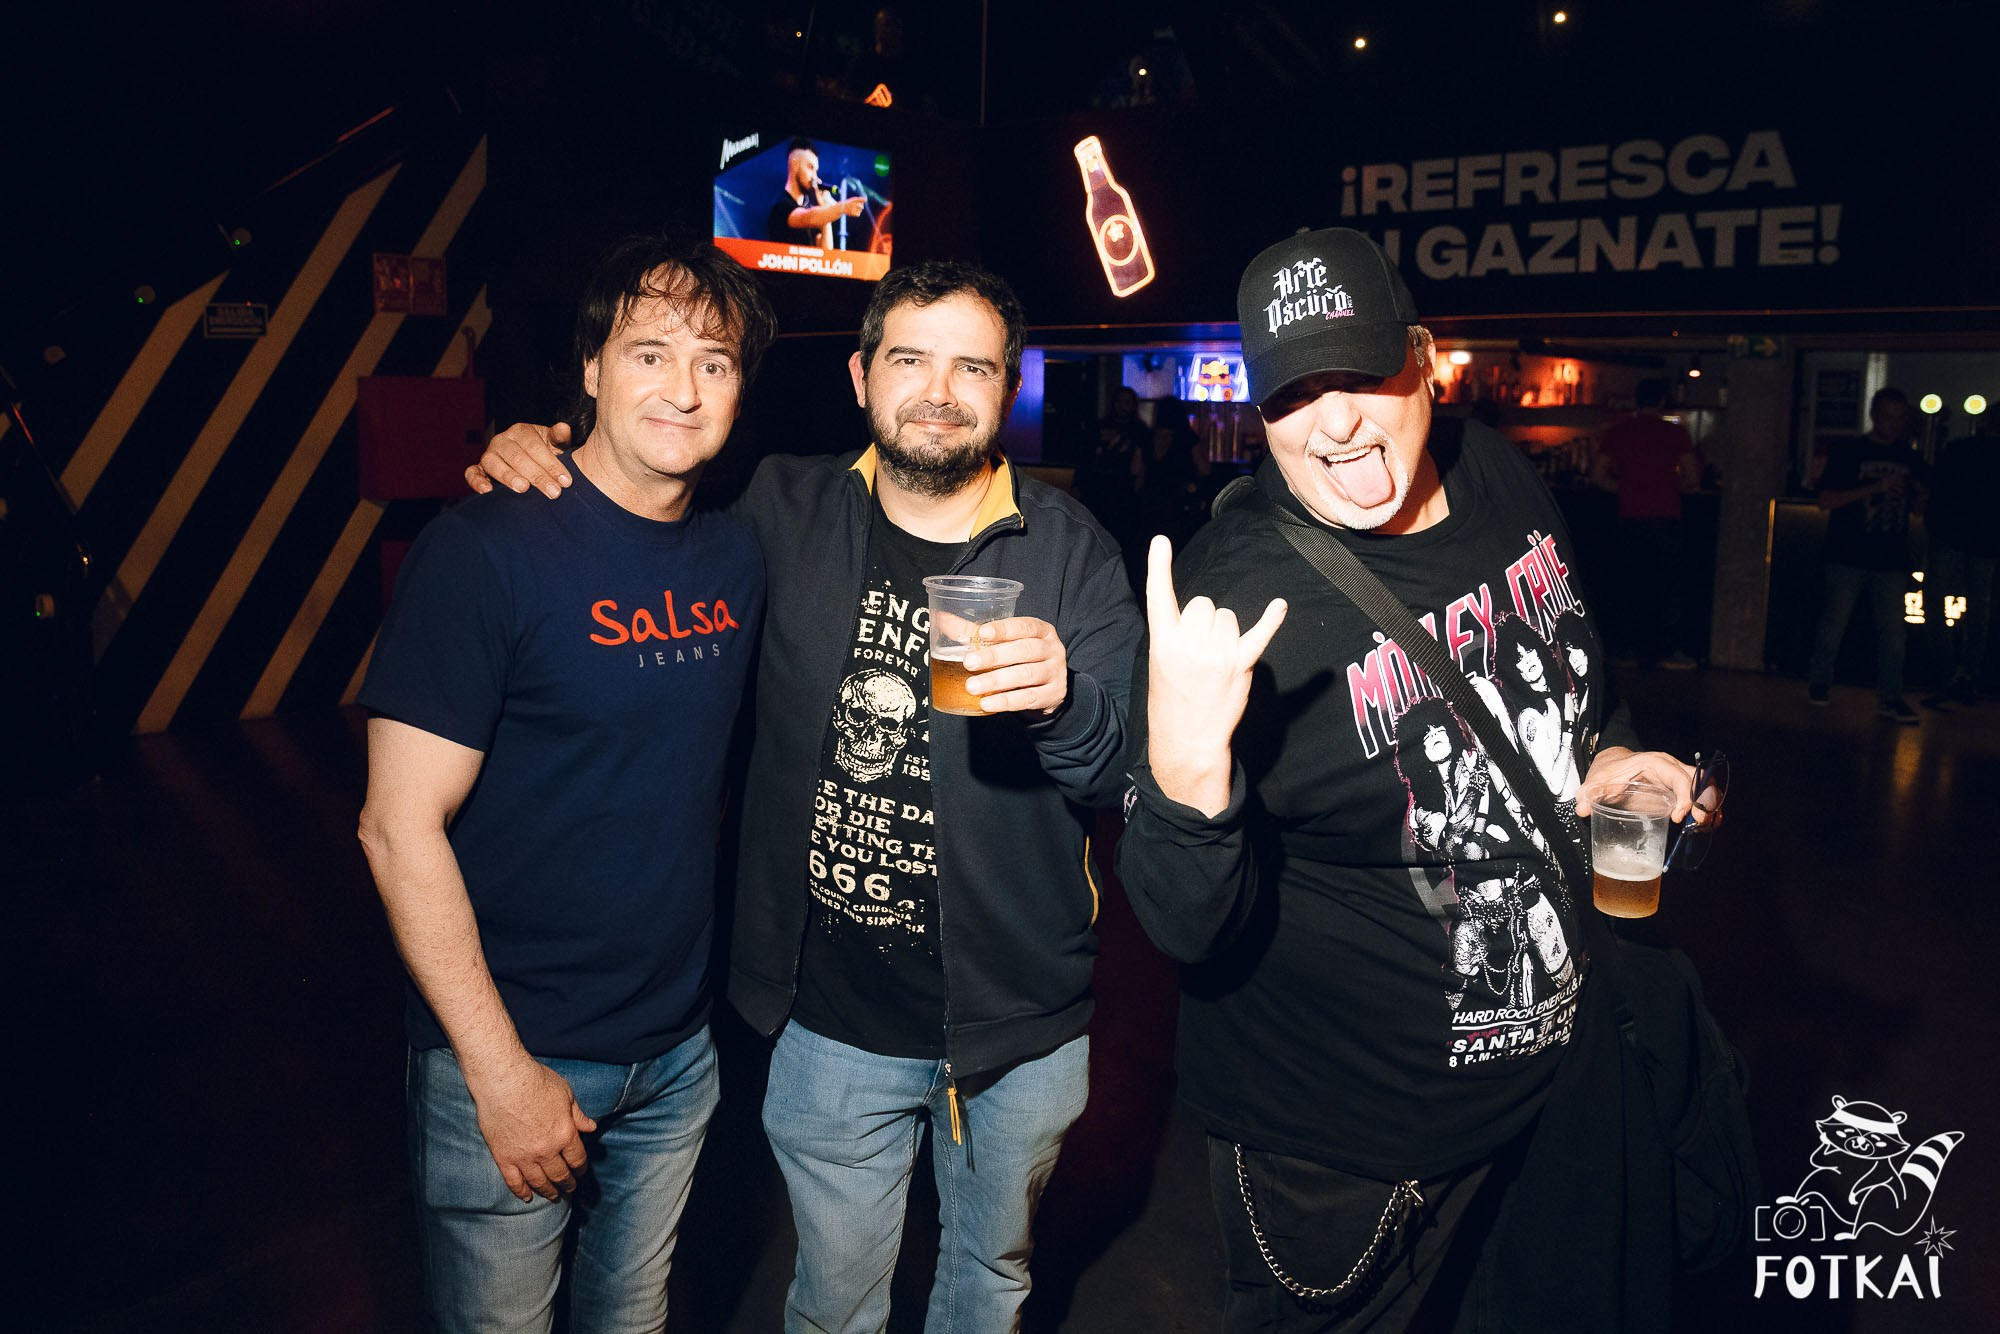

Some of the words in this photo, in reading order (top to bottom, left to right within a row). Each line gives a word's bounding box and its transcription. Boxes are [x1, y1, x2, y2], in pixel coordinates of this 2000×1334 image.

[1340, 130, 1797, 217] ¡REFRESCA
[1415, 203, 1843, 280] GAZNATE!
[758, 253, 798, 271] JOHN
[638, 643, 721, 668] JEANS
[853, 647, 920, 678] FOREVER
[1346, 583, 1496, 760] MÖEY
[904, 753, 930, 767] EST
[843, 787, 897, 815] THE
[901, 803, 936, 825] DA
[848, 809, 891, 834] DIE
[825, 836, 874, 864] YOU
[878, 853, 938, 877] LOST
[809, 848, 891, 901] 666
[843, 906, 864, 924] AND
[1452, 1010, 1495, 1024] HARD
[1494, 1004, 1537, 1020] ROCK
[1451, 1027, 1535, 1054] SANTA
[1448, 1055, 1458, 1068] 8
